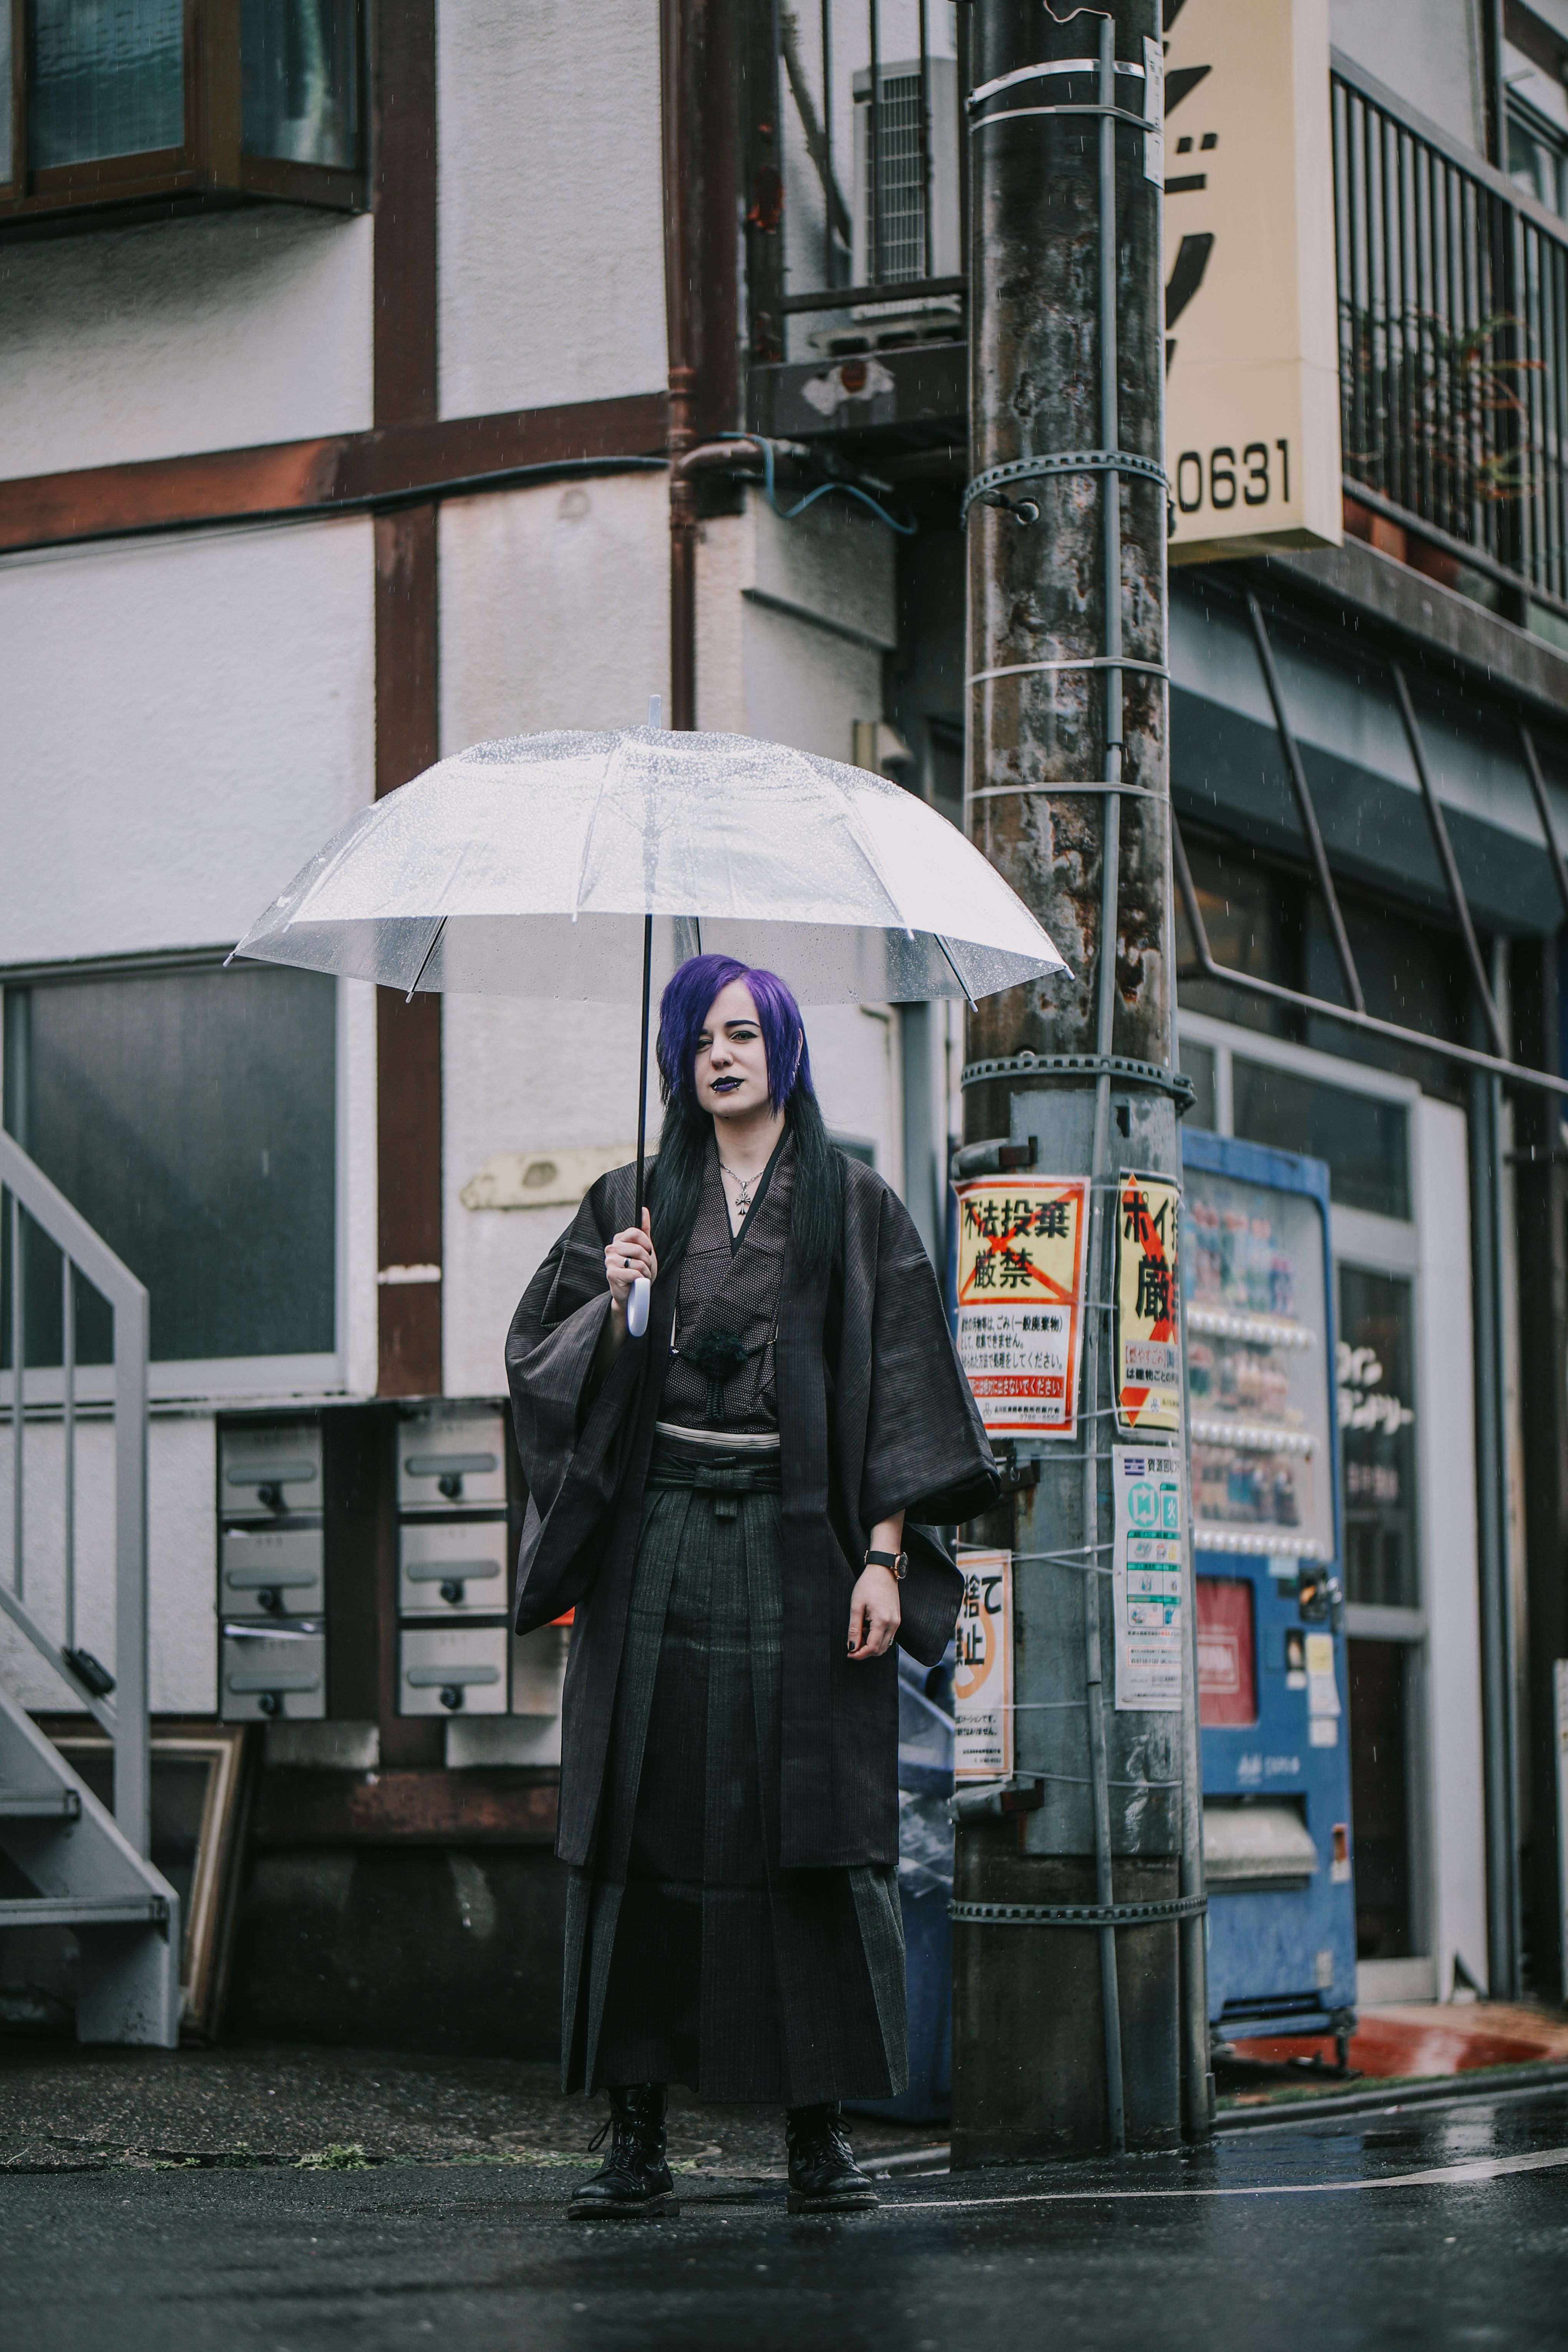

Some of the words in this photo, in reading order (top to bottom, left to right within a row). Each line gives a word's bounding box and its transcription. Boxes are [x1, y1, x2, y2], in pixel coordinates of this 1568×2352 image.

[1177, 439, 1289, 513] 0631
[964, 1198, 1071, 1240] 不法投棄
[974, 1248, 1033, 1290] 厳禁
[964, 1574, 1002, 1618] 捨て
